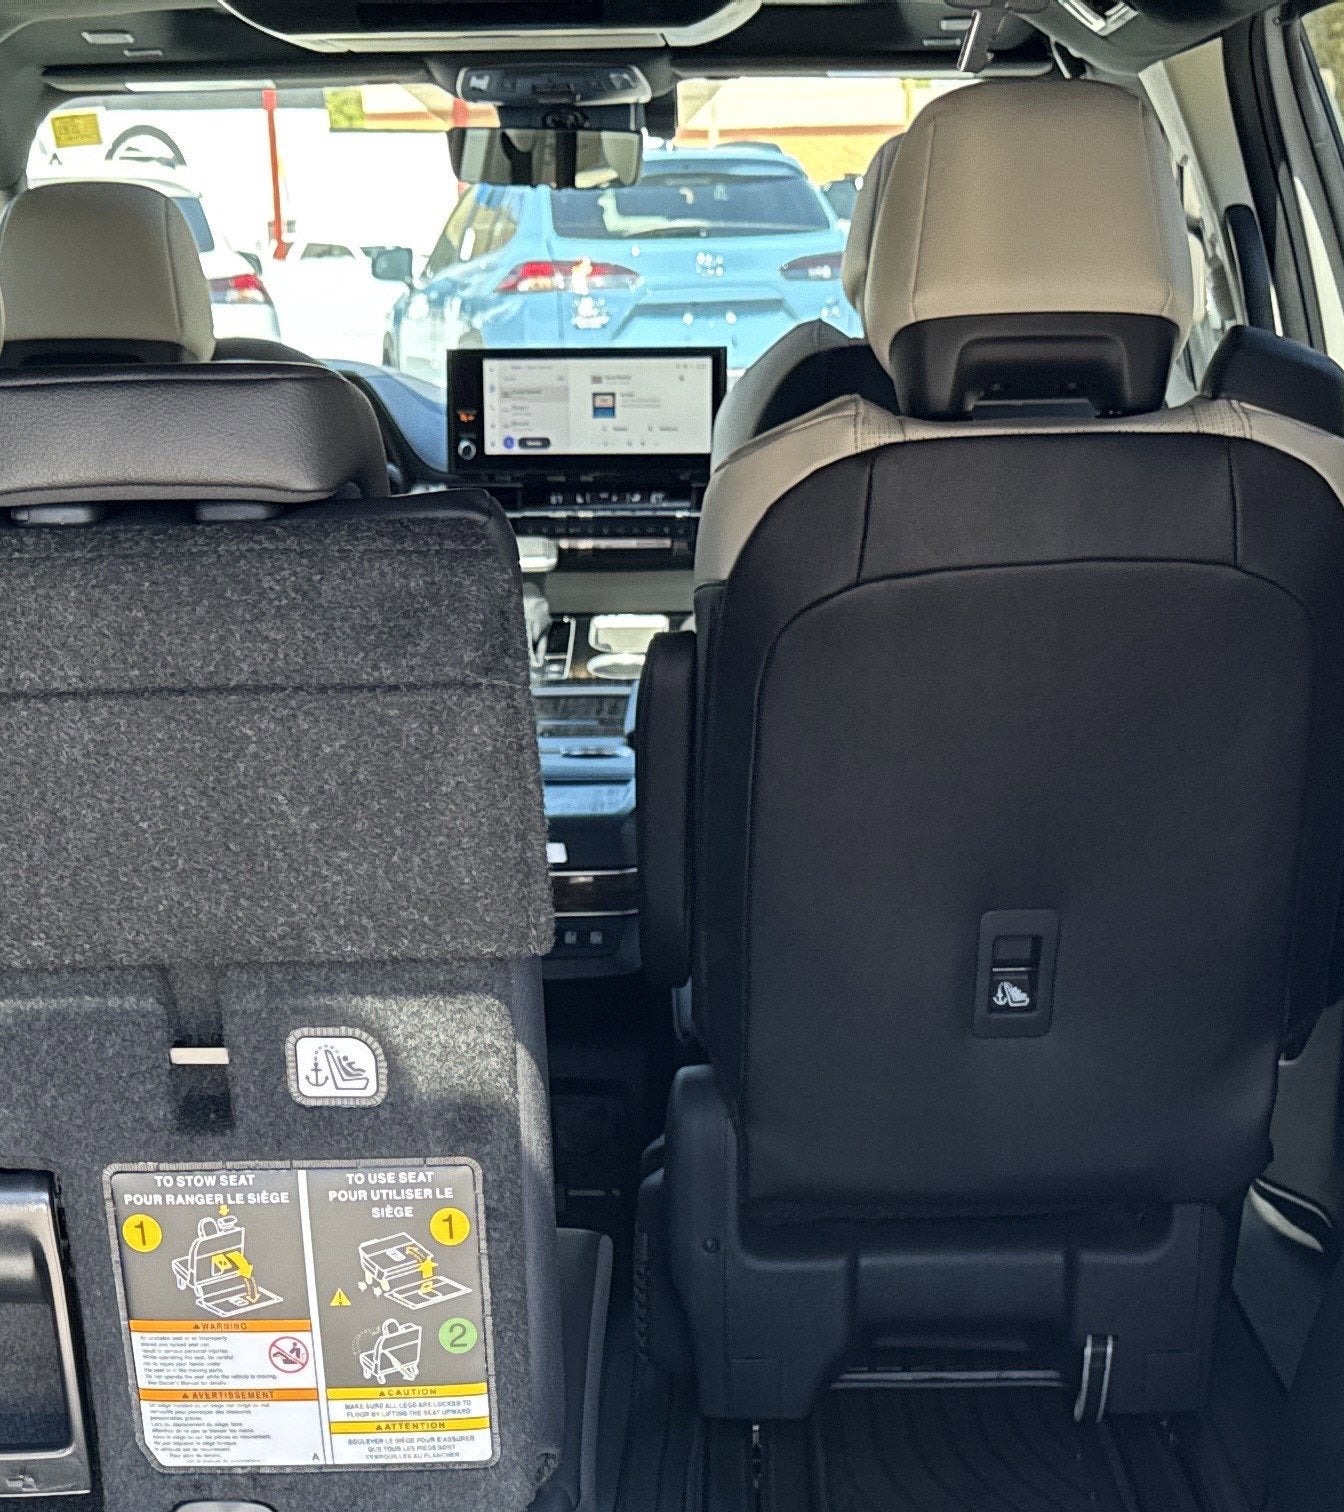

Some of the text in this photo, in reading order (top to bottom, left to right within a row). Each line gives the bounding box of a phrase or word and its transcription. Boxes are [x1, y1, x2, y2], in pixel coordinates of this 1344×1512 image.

[154, 1174, 255, 1187] TO STOW SEAT
[346, 1172, 434, 1184] TO USE SEAT
[124, 1190, 290, 1205] POUR RANGER LE SIÈGE
[329, 1188, 453, 1202] POUR UTILISER LE
[372, 1205, 413, 1218] SIÈGE
[442, 1214, 454, 1239] 1
[134, 1221, 146, 1246] 1
[450, 1323, 468, 1348] 2
[193, 1391, 274, 1399] AVERTISSEMENT
[385, 1422, 446, 1430] ATTENTION
[312, 1453, 320, 1461] A
